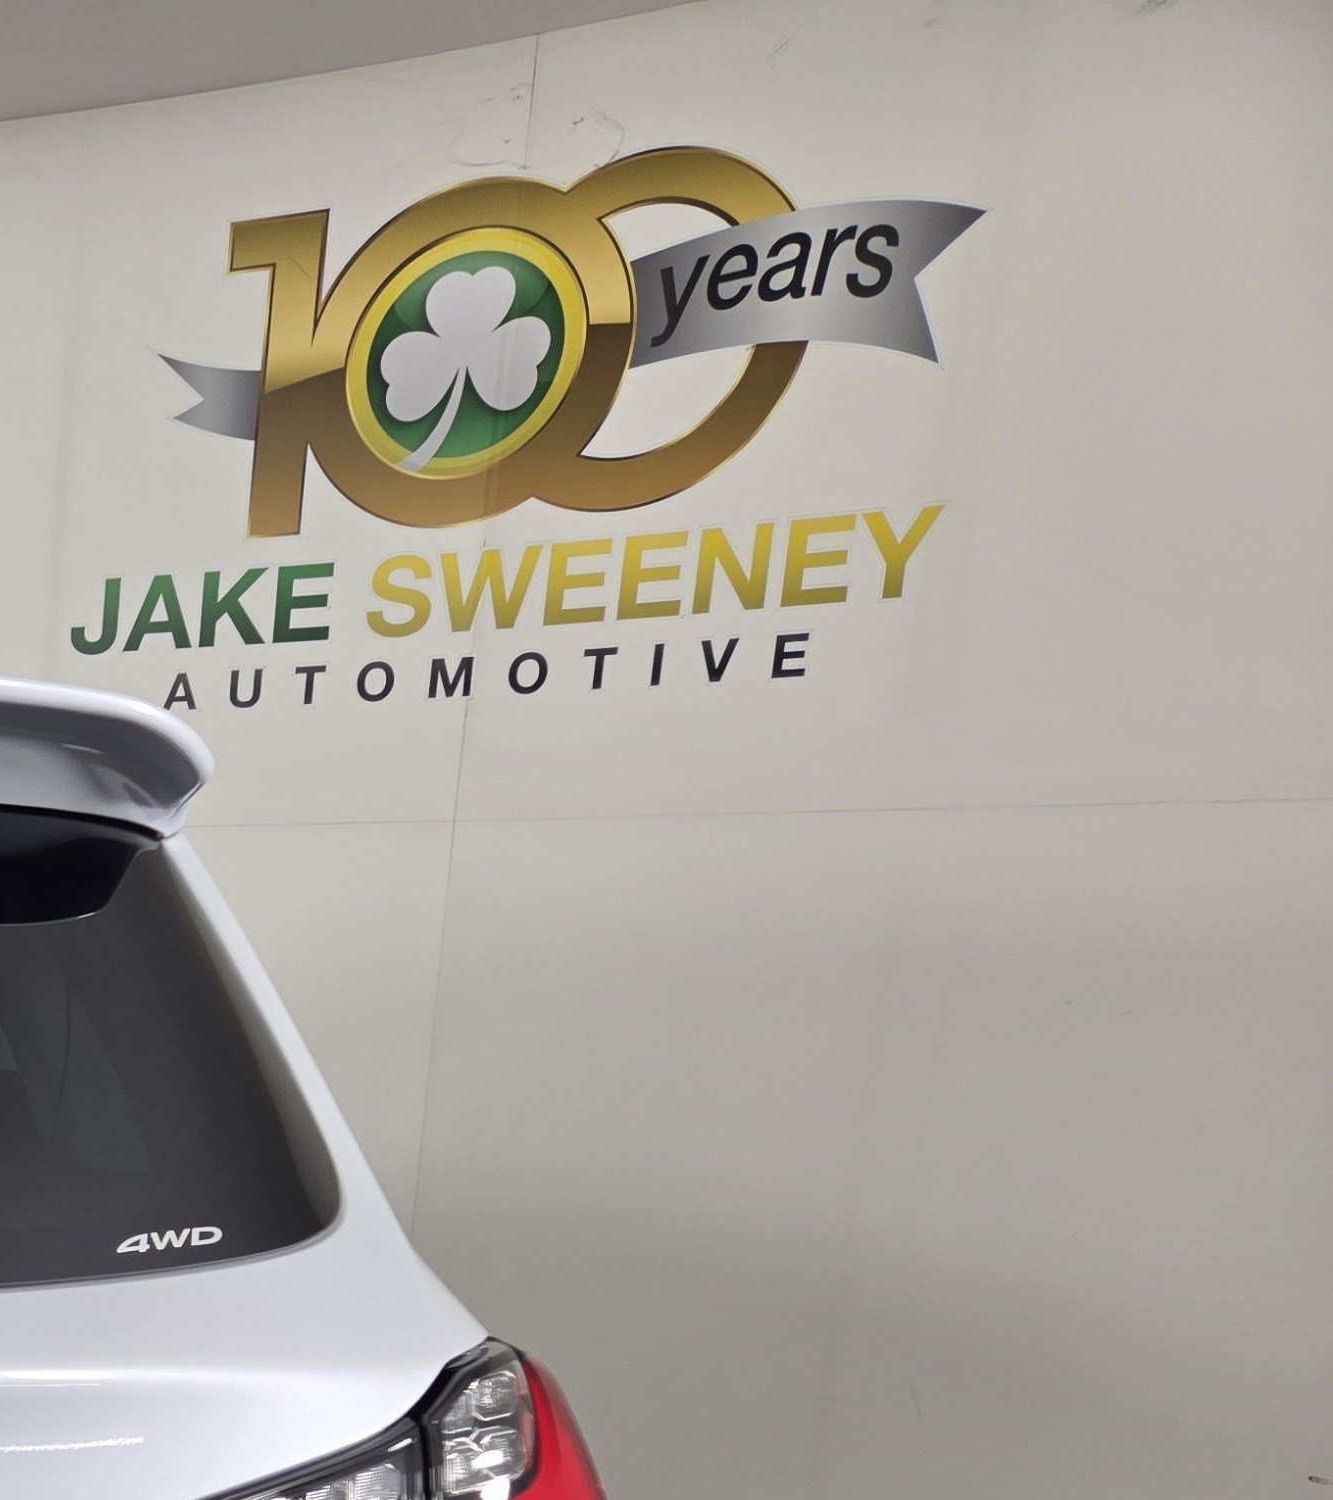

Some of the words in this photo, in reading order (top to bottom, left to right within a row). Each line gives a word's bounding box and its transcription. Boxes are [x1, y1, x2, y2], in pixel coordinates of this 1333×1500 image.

[226, 145, 813, 538] 100
[651, 221, 900, 346] years
[70, 562, 335, 658] JAKE
[365, 504, 945, 638] SWEENEY
[163, 632, 812, 712] AUTOMOTIVE
[115, 1226, 223, 1254] 4WD
